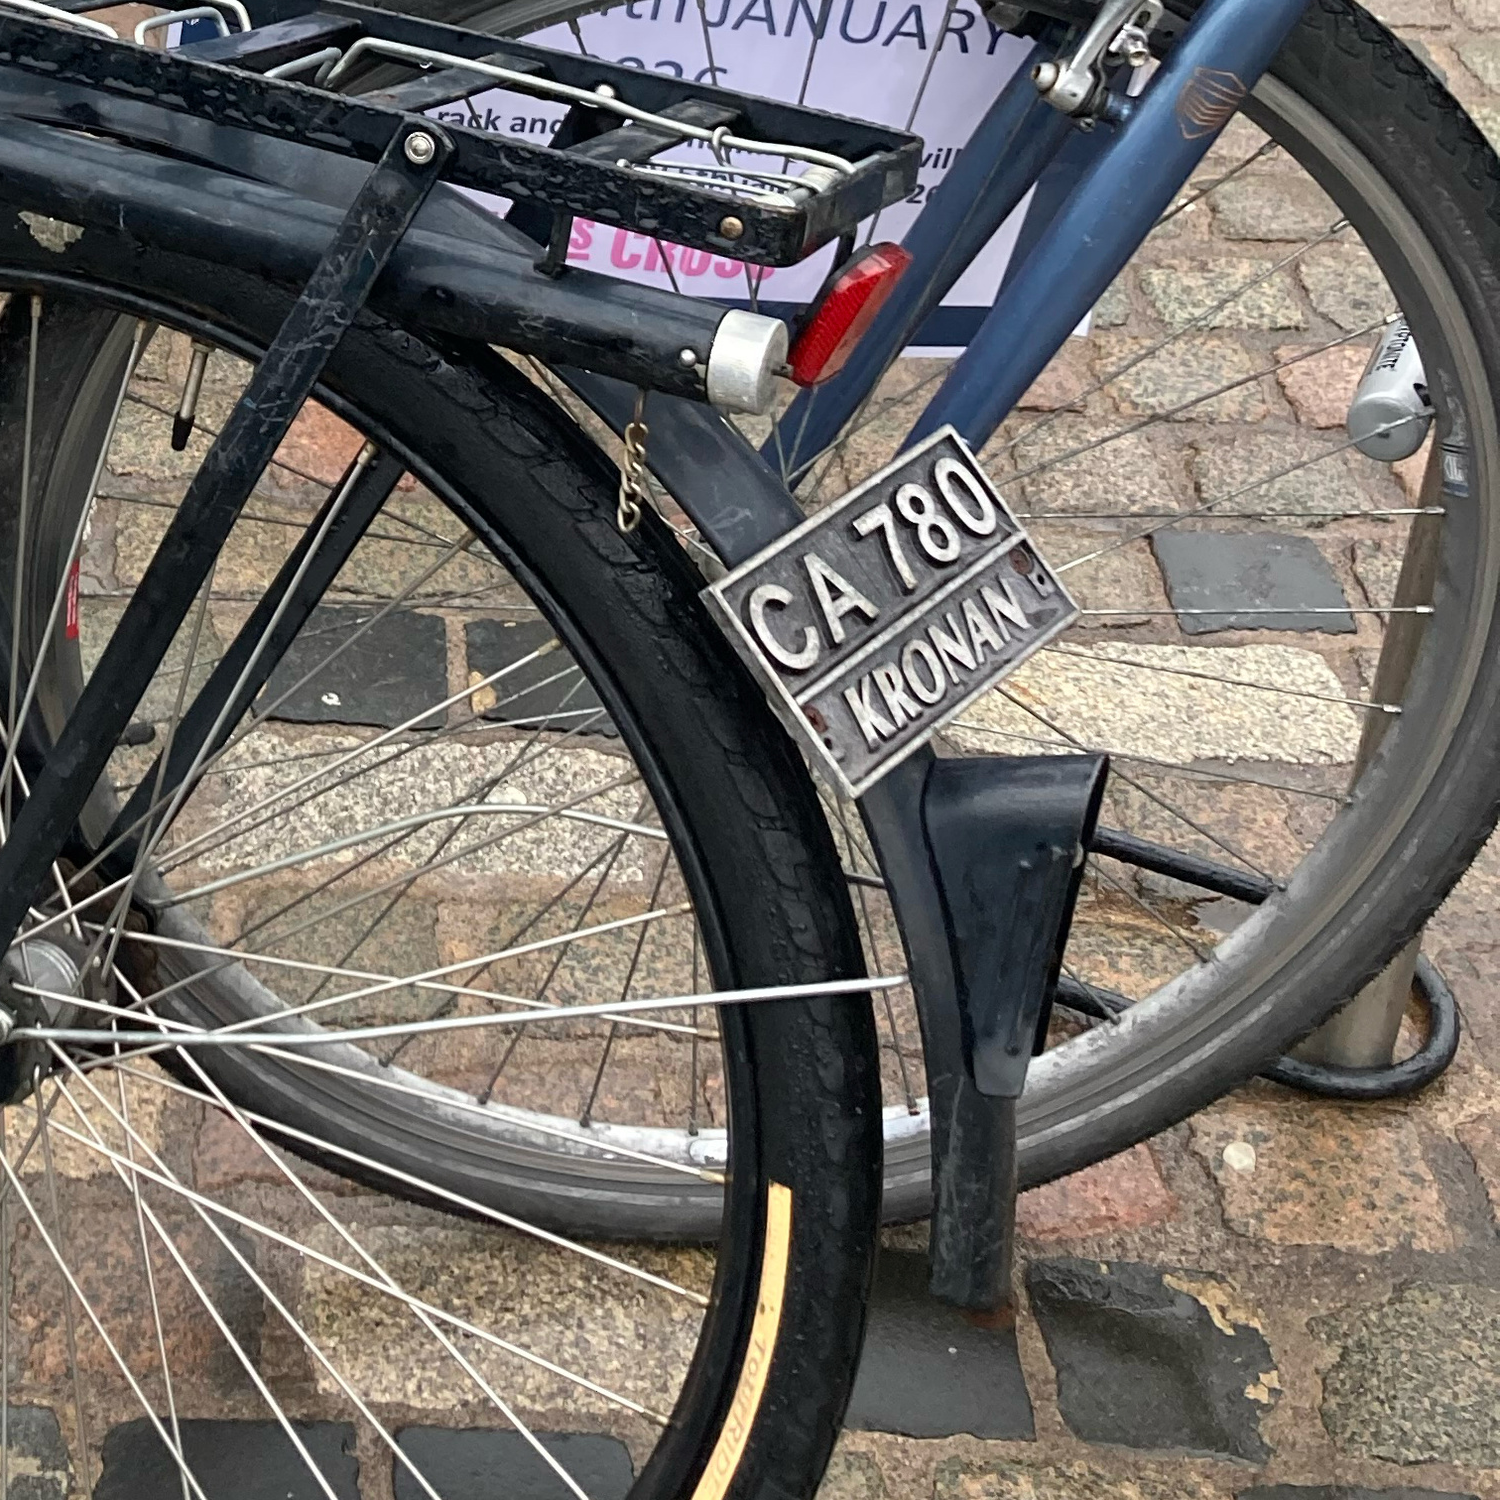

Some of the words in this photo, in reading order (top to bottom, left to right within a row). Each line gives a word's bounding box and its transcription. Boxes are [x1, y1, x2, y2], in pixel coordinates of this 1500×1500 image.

[437, 108, 500, 132] rack
[748, 553, 880, 670] CA
[851, 457, 998, 590] 780
[844, 579, 1031, 751] KRONAN
